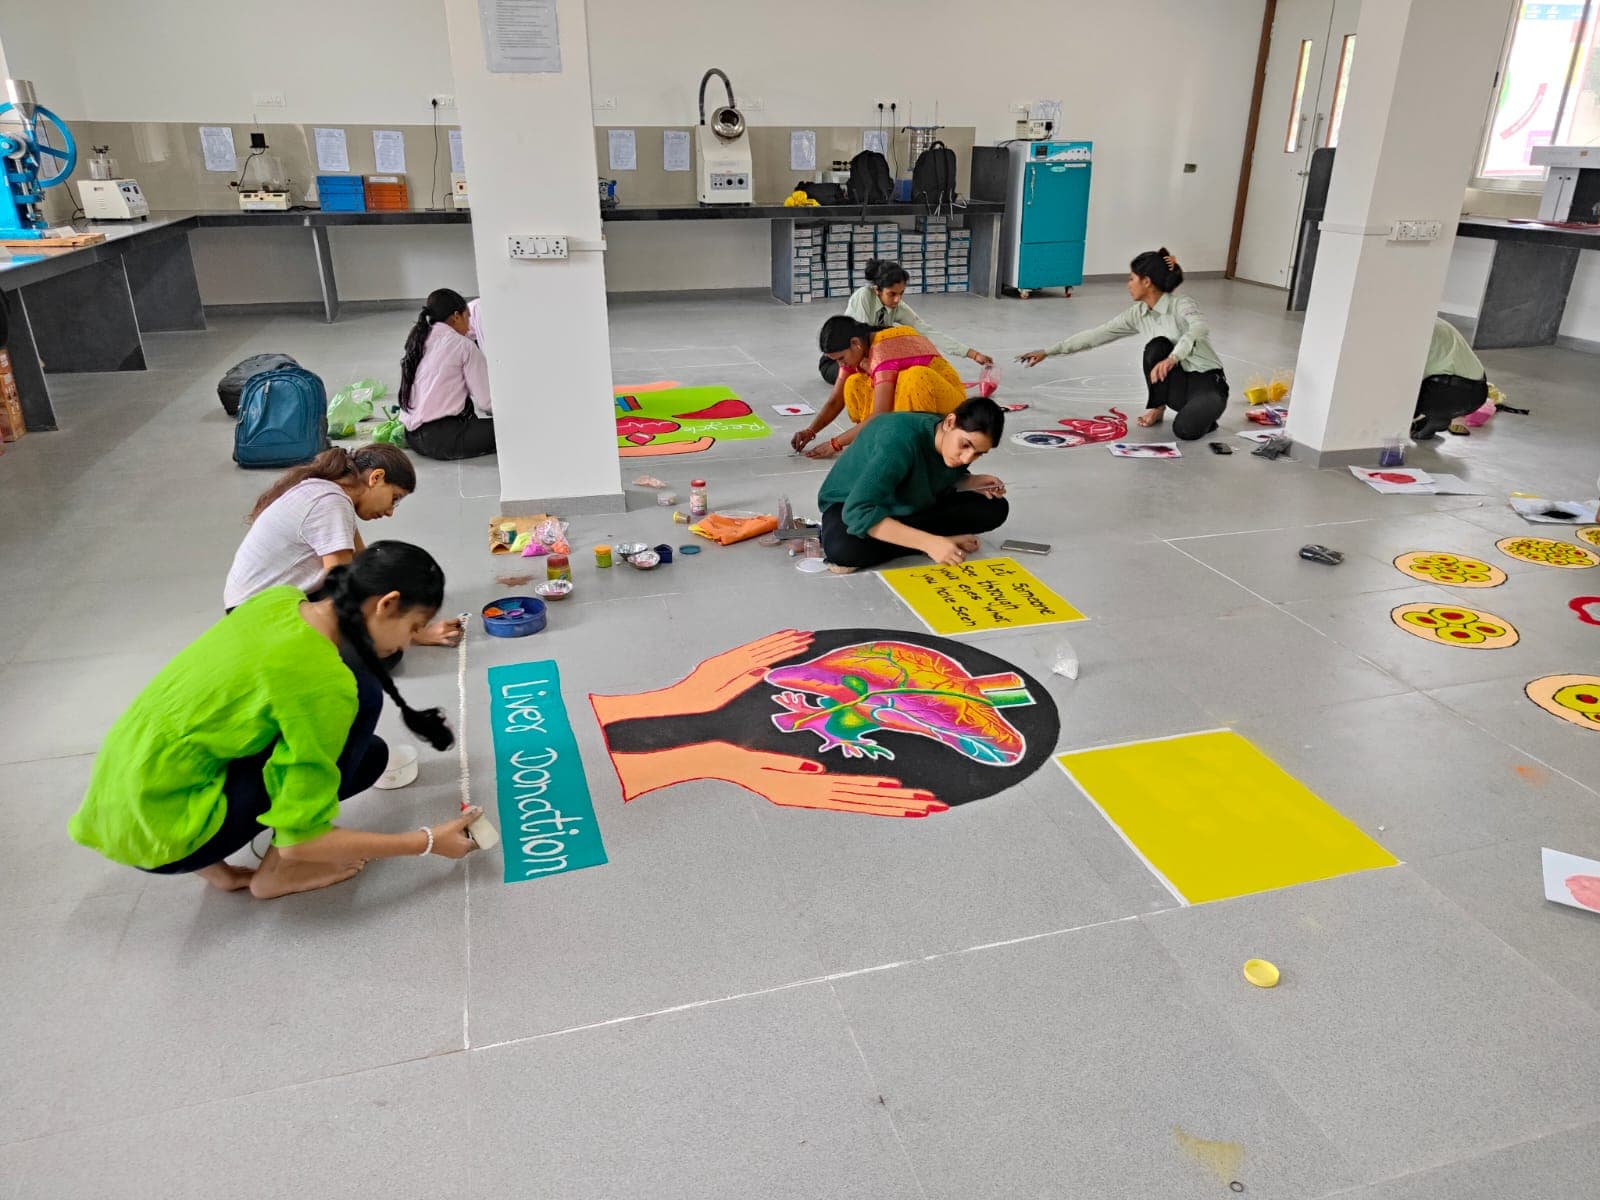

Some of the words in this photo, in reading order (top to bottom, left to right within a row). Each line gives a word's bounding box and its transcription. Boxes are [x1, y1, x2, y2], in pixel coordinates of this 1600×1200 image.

[987, 564, 1016, 577] Let
[977, 580, 1019, 610] through
[502, 680, 549, 733] Liver
[510, 747, 583, 876] Donation
